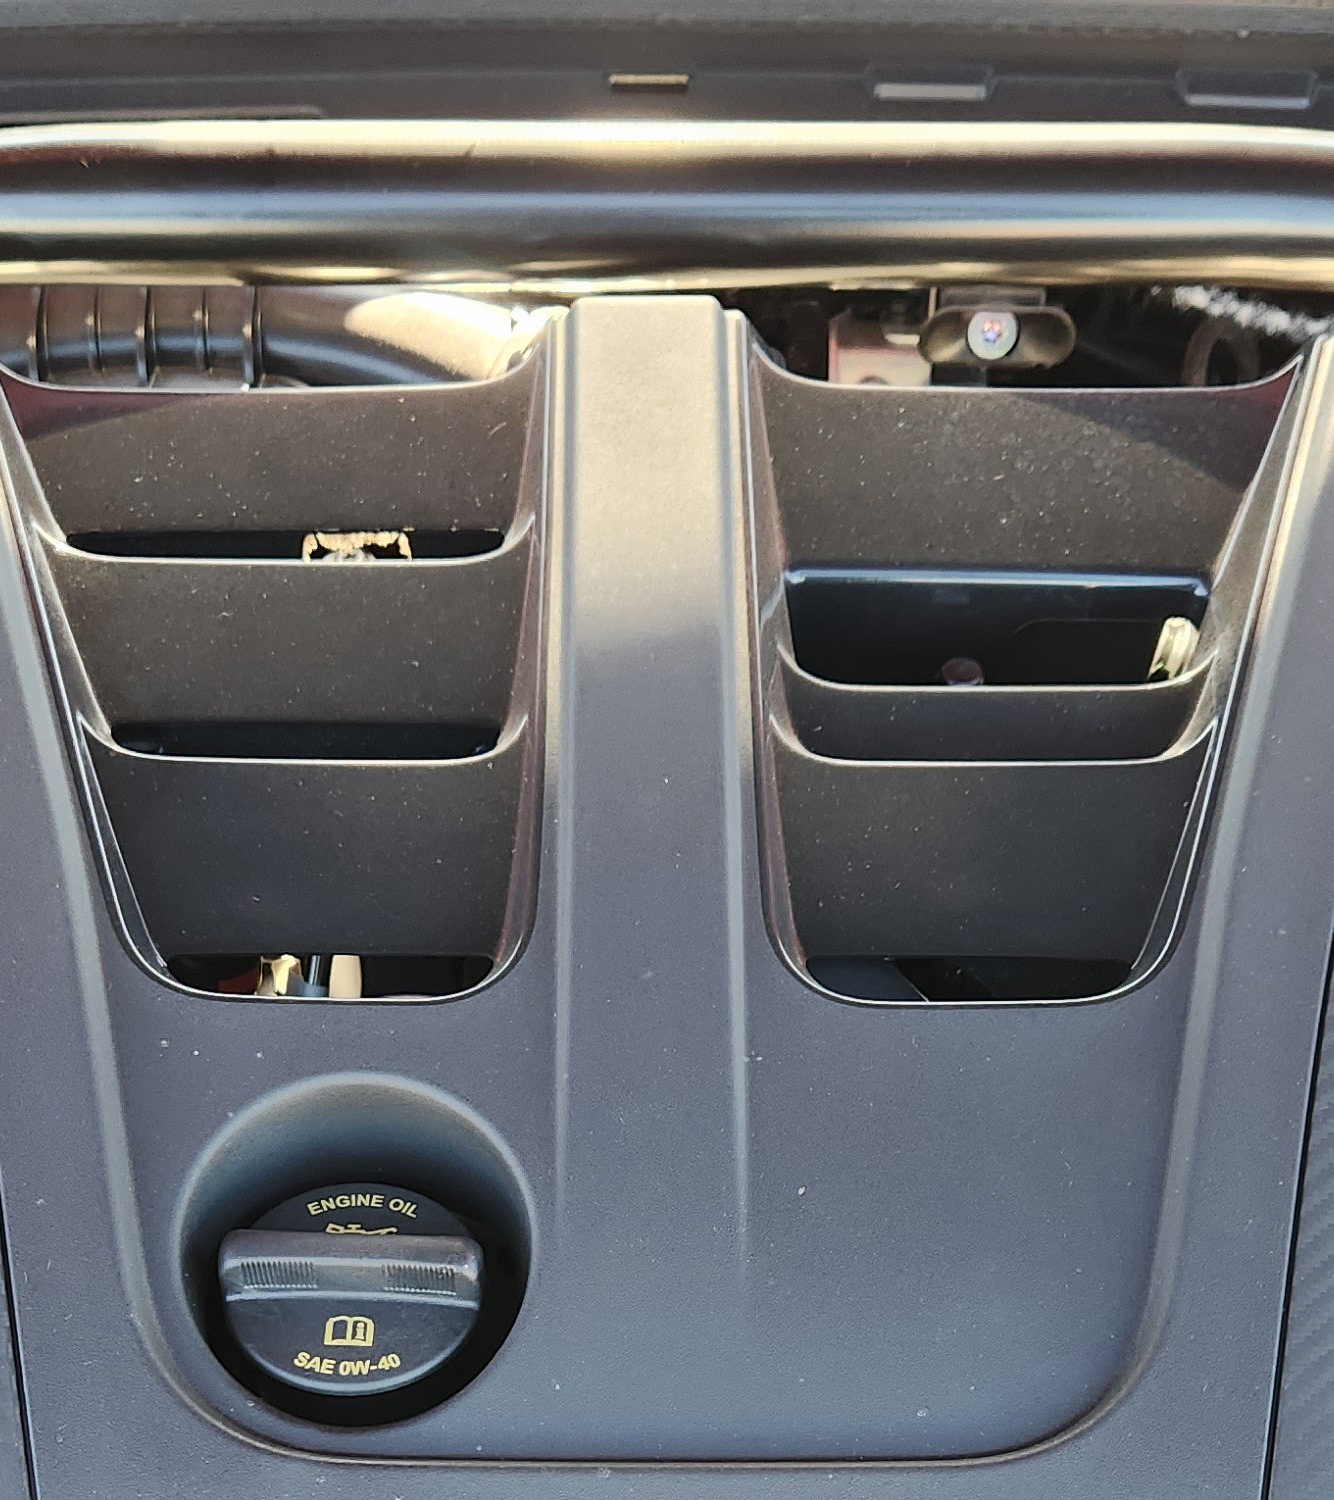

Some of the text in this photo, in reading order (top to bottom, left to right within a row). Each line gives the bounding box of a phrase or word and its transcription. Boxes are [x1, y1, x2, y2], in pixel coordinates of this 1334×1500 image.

[306, 1193, 418, 1218] ENGINE OIL
[293, 1351, 401, 1376] SAE 0W-40
